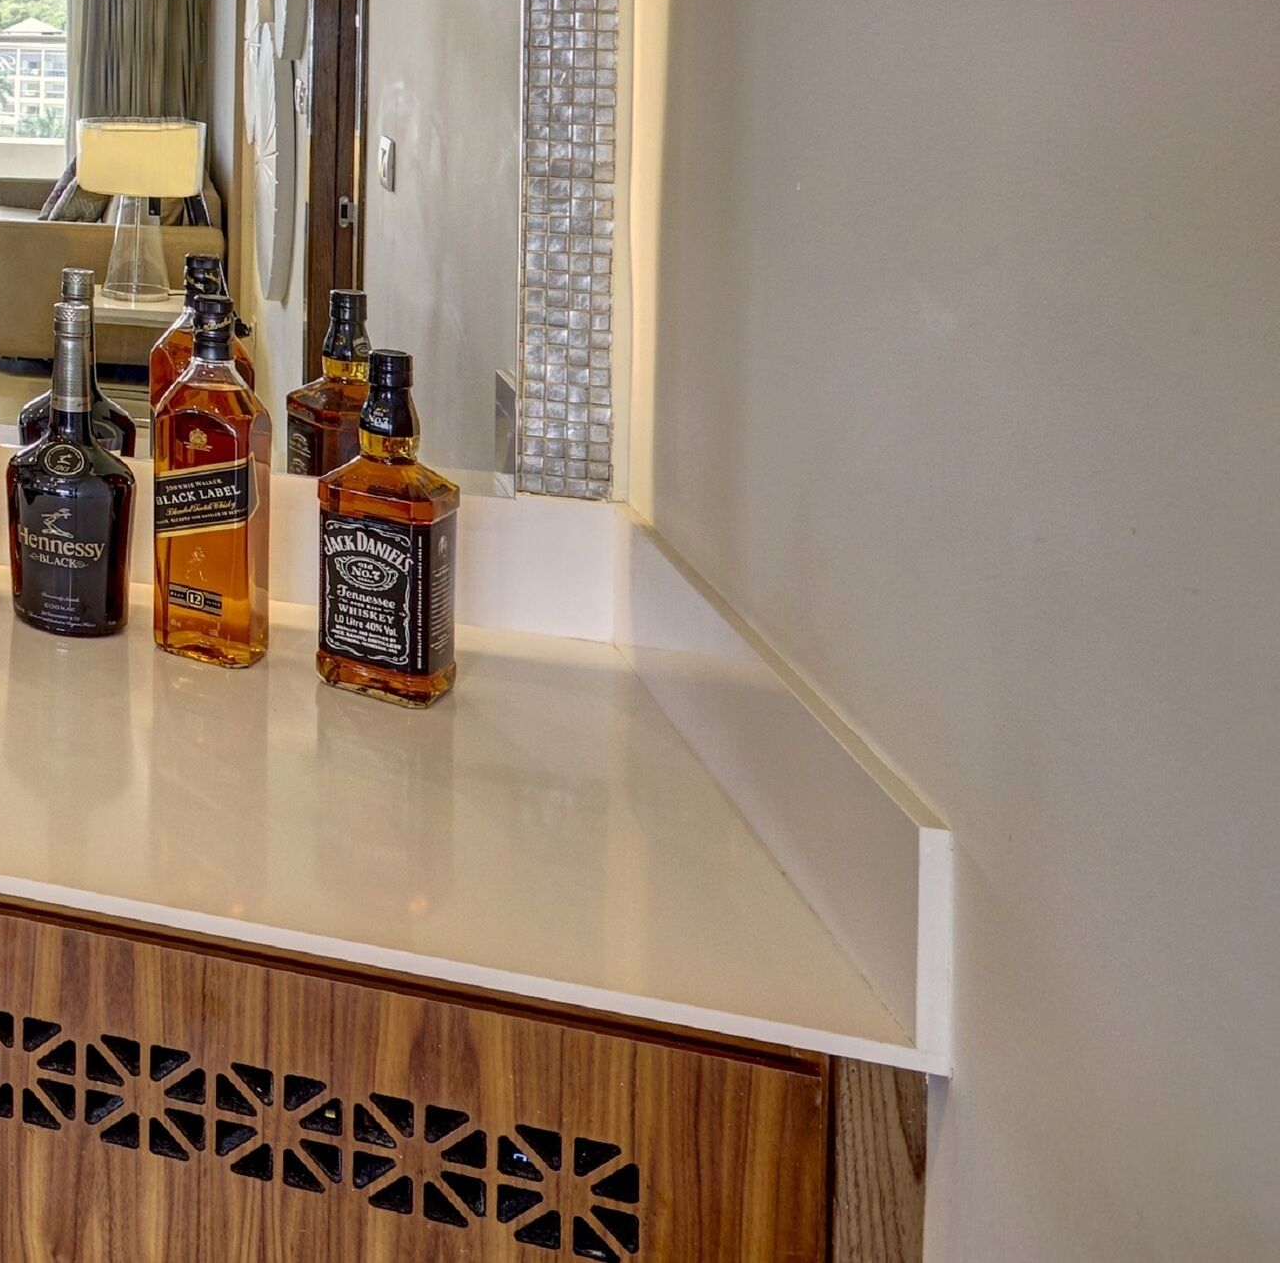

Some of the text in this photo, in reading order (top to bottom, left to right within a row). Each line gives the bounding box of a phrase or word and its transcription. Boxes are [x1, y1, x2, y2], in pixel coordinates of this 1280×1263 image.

[156, 484, 241, 506] BLACK LABEL
[18, 523, 105, 561] Hennessy
[324, 531, 414, 572] JACK DANIEL'S
[39, 553, 77, 569] BLACK
[189, 593, 201, 605] 12
[336, 584, 396, 609] Tennessee
[338, 602, 396, 624] WHISKEY
[346, 616, 364, 629] Litre
[365, 622, 383, 633] 40%
